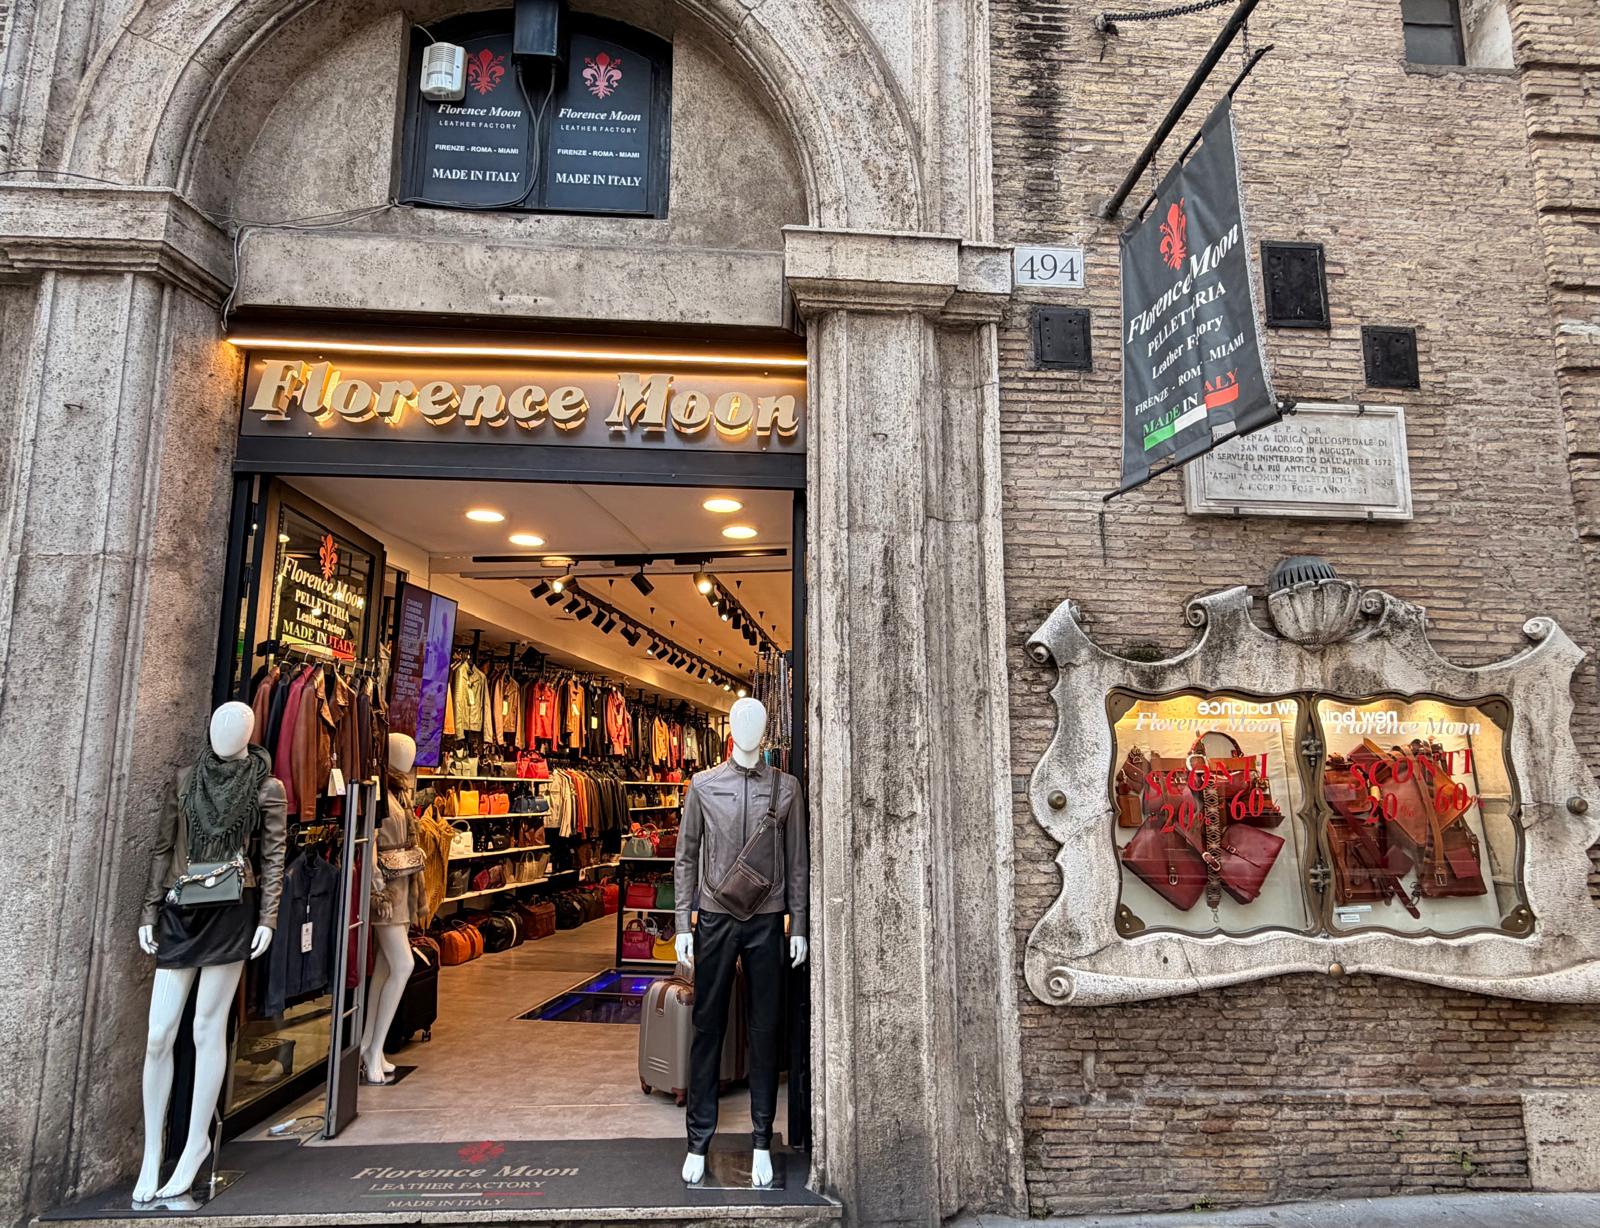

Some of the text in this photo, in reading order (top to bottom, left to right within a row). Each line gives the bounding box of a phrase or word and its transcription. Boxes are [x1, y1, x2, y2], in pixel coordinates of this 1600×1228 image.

[437, 104, 522, 118] Florence Moon
[558, 108, 641, 122] Florence Moon
[439, 120, 517, 130] LEATHER FACTORY
[434, 144, 466, 152] FIRENZE
[557, 148, 588, 156] FIRENZE
[432, 168, 520, 183] MADE IN ITALY
[555, 173, 642, 187] MADE IN ITALY
[1019, 254, 1080, 282] 494
[1126, 223, 1239, 345] Florence Moon
[1147, 281, 1226, 358] PELLETTRIA
[1152, 343, 1184, 380] Leather
[1135, 386, 1170, 416] FIRENZE
[1209, 331, 1245, 362] MIAMI
[249, 359, 800, 437] Florence Moon
[1142, 367, 1239, 437] MADE IN ALY
[1274, 435, 1304, 445] IDRICA
[1378, 439, 1388, 448] DI
[1306, 447, 1315, 455] IN
[1319, 448, 1356, 456] AUGUSTA
[1217, 453, 1254, 461] SERVIZIO
[1252, 464, 1264, 472] LA
[1285, 466, 1317, 474] ANTICA
[282, 556, 334, 597] Florence
[294, 589, 350, 624] PELLETTERIA
[282, 619, 356, 655] MADE IN ITALY
[323, 618, 347, 640] Factory
[1135, 711, 1282, 735] Florence Moon
[1335, 716, 1481, 736] Florence Moon
[1143, 752, 1270, 803] SCONTI
[1349, 748, 1474, 792] SCONTI
[350, 1164, 580, 1180] Florence Moon
[368, 1179, 547, 1192] LEATHER FACTORY
[386, 1200, 437, 1208] MADE
[456, 1198, 506, 1207] ITALY
